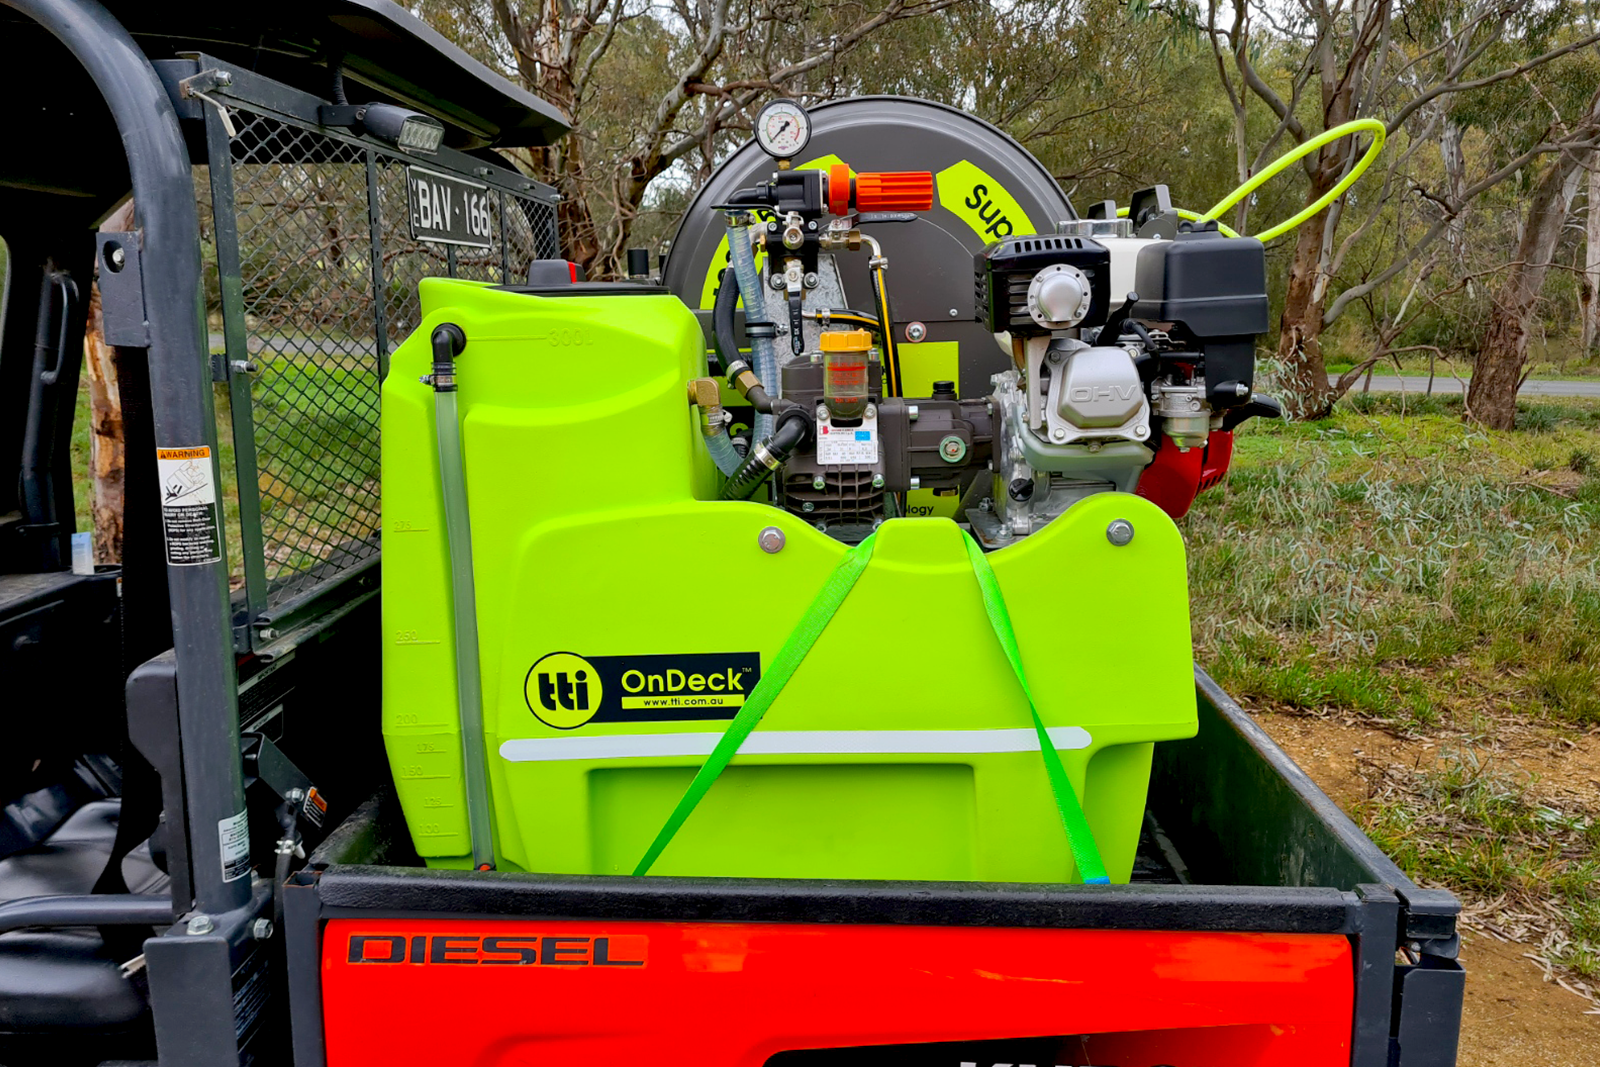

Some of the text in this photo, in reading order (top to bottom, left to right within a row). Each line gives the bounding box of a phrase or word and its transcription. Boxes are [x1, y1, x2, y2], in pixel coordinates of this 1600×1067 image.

[1070, 384, 1137, 403] OHV
[165, 450, 205, 458] WARNING
[906, 505, 934, 516] logy
[621, 667, 744, 693] OnDeck
[537, 669, 589, 711] tti
[643, 697, 724, 707] www.tti.com.au
[396, 713, 418, 725] 200
[402, 765, 423, 776] 150
[348, 935, 645, 966] DIESEL
